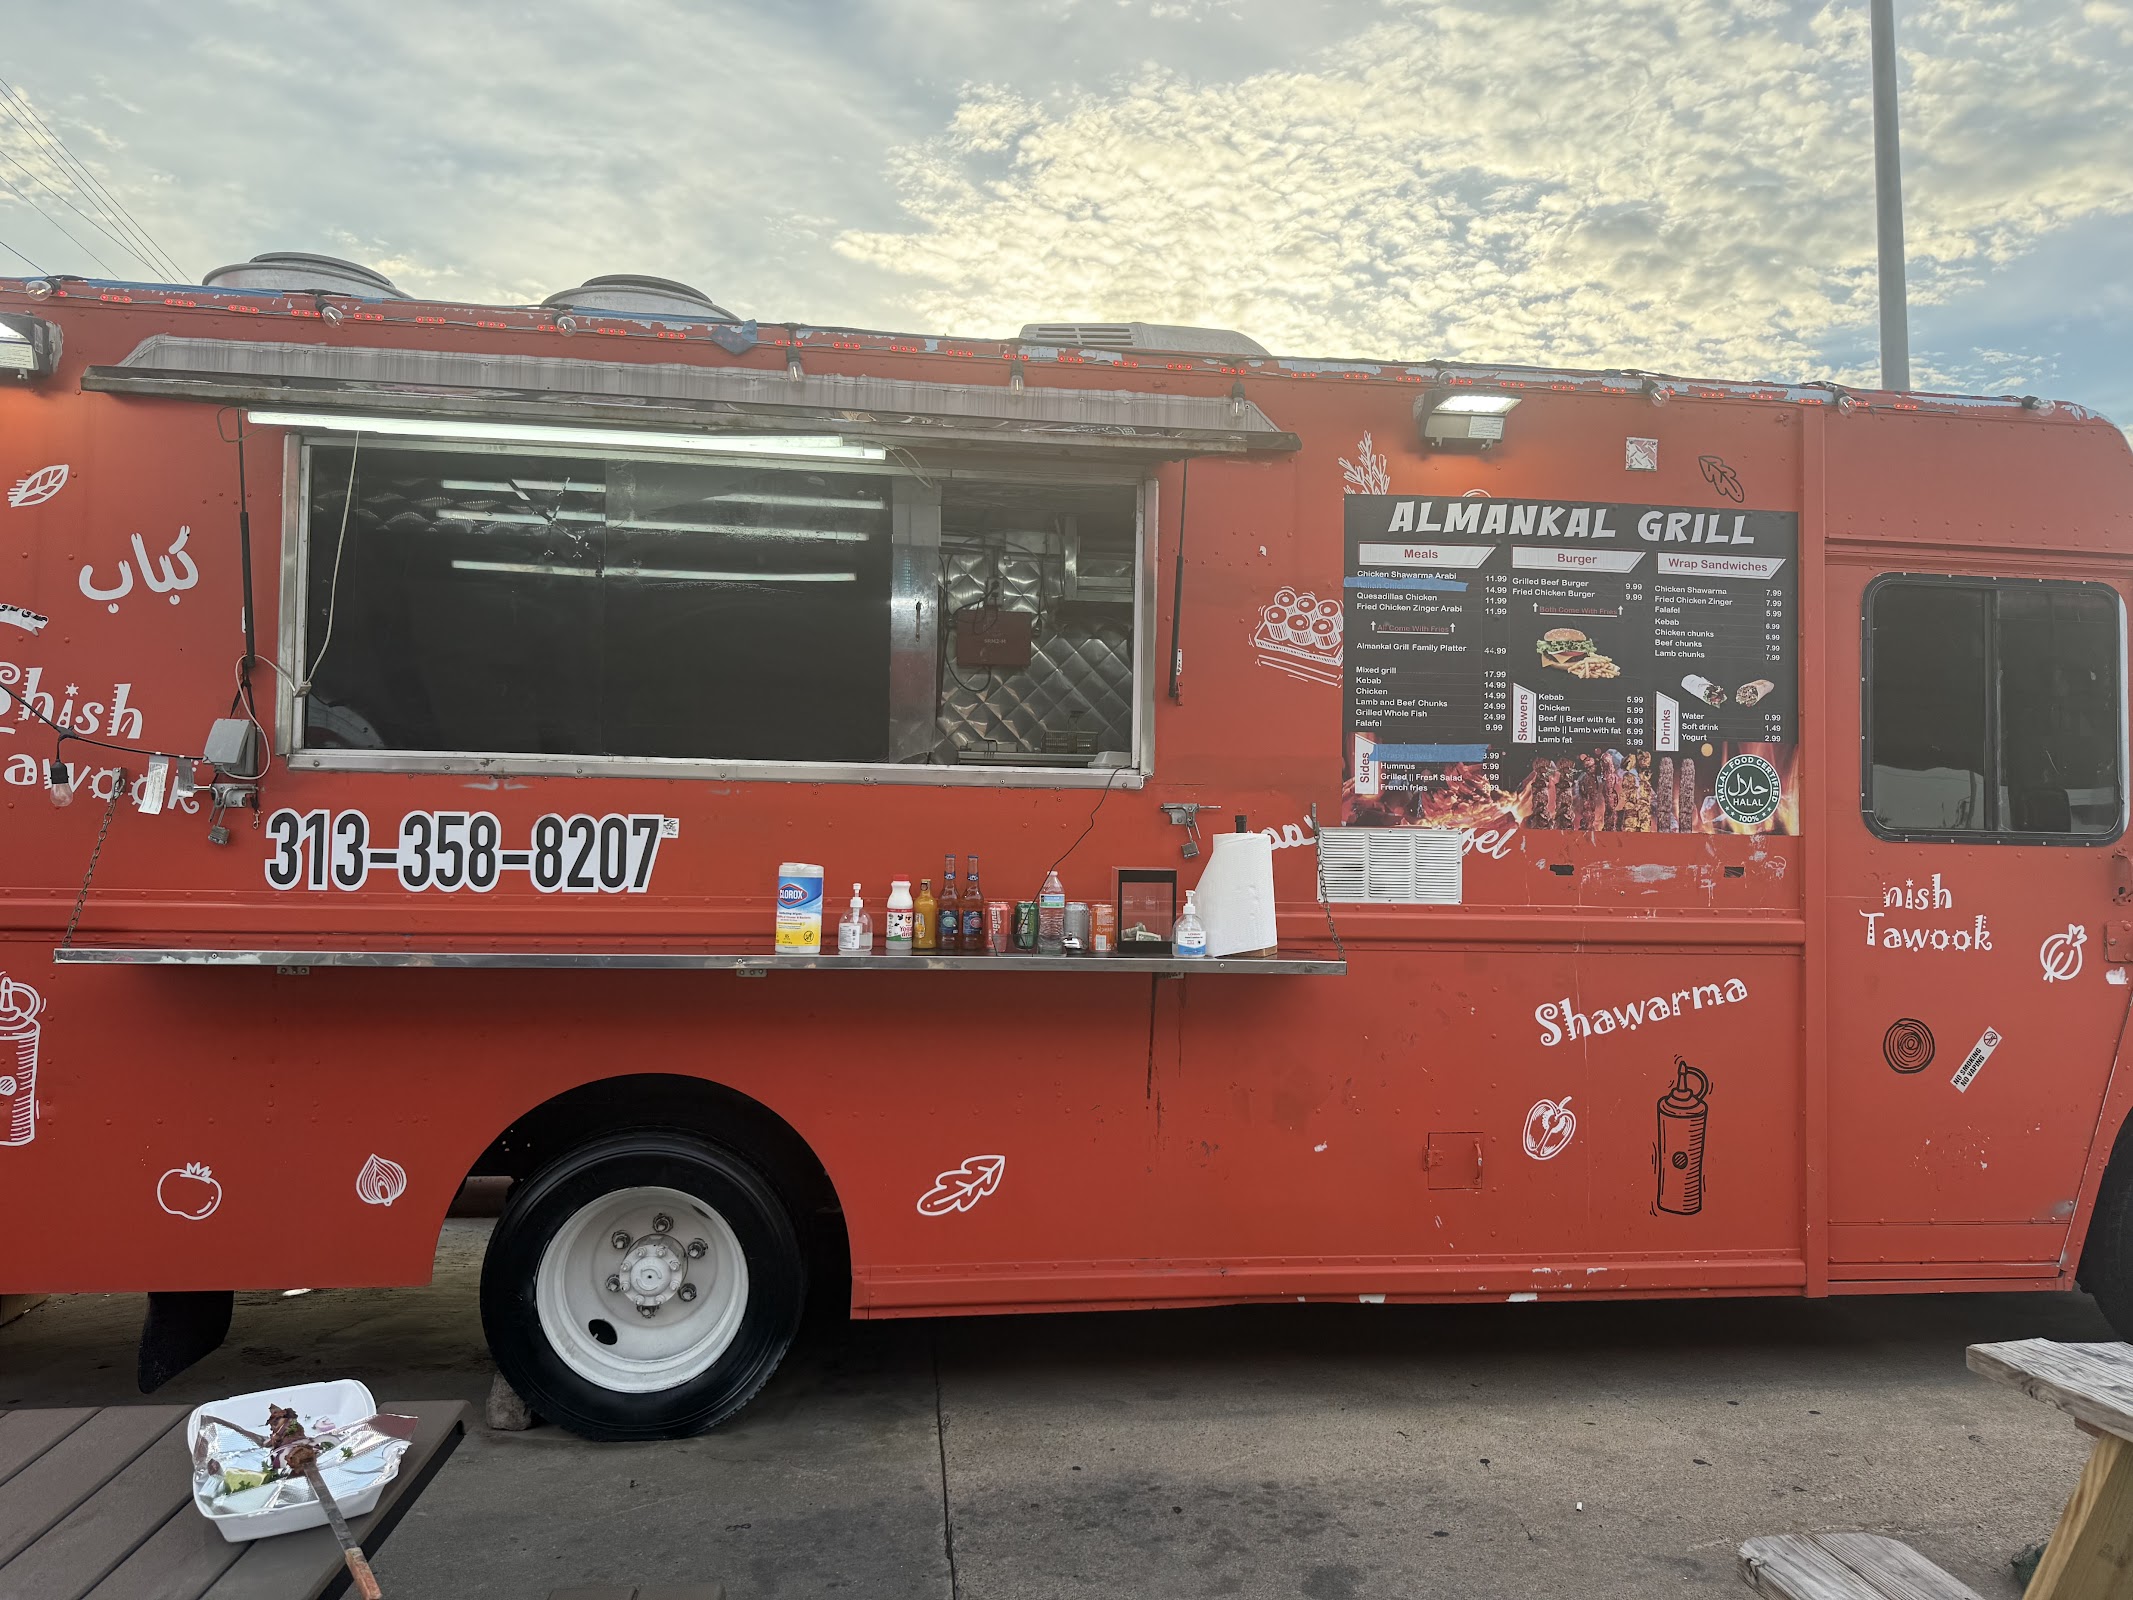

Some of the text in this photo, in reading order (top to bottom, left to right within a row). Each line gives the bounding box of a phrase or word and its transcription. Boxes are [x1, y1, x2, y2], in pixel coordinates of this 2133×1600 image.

[1387, 501, 1754, 545] ALMANKAL GRILL
[1404, 549, 1438, 558] Meals
[1558, 554, 1597, 565] Burger
[1669, 558, 1767, 571] Wrap Sandwiches
[79, 525, 199, 613] كباب
[1391, 571, 1433, 579] Shawarma
[1562, 580, 1589, 588] Burger
[1357, 592, 1403, 600] Quesadillas
[1568, 590, 1595, 598] Burger
[1708, 598, 1732, 606] Zinger
[1413, 605, 1439, 613] Zinger
[1655, 606, 1680, 614] Falafel
[1655, 618, 1679, 626] Kebab
[1687, 630, 1714, 638] chunks
[1412, 644, 1438, 652] Family
[1675, 640, 1702, 648] chunks
[1381, 667, 1396, 675] grill
[1518, 694, 1527, 741] Skewers
[1569, 726, 1590, 734] Lamb
[1661, 710, 1670, 744] Drinks
[1562, 736, 1572, 744] fat
[1682, 734, 1707, 742] Yogurt
[1360, 753, 1369, 783] Sides
[1380, 773, 1407, 781] Grilled
[1719, 757, 1778, 803] HALAL FOOD CERTIFIED
[1728, 773, 1768, 796] حلال
[266, 809, 664, 893] 313-358-8207
[780, 890, 803, 899] CLOROX
[1859, 910, 1992, 952] Tawook
[1535, 978, 1748, 1047] Shawarma
[1953, 1048, 1981, 1085] NO SMOKING
[1960, 1055, 1985, 1086] NO VAPING
